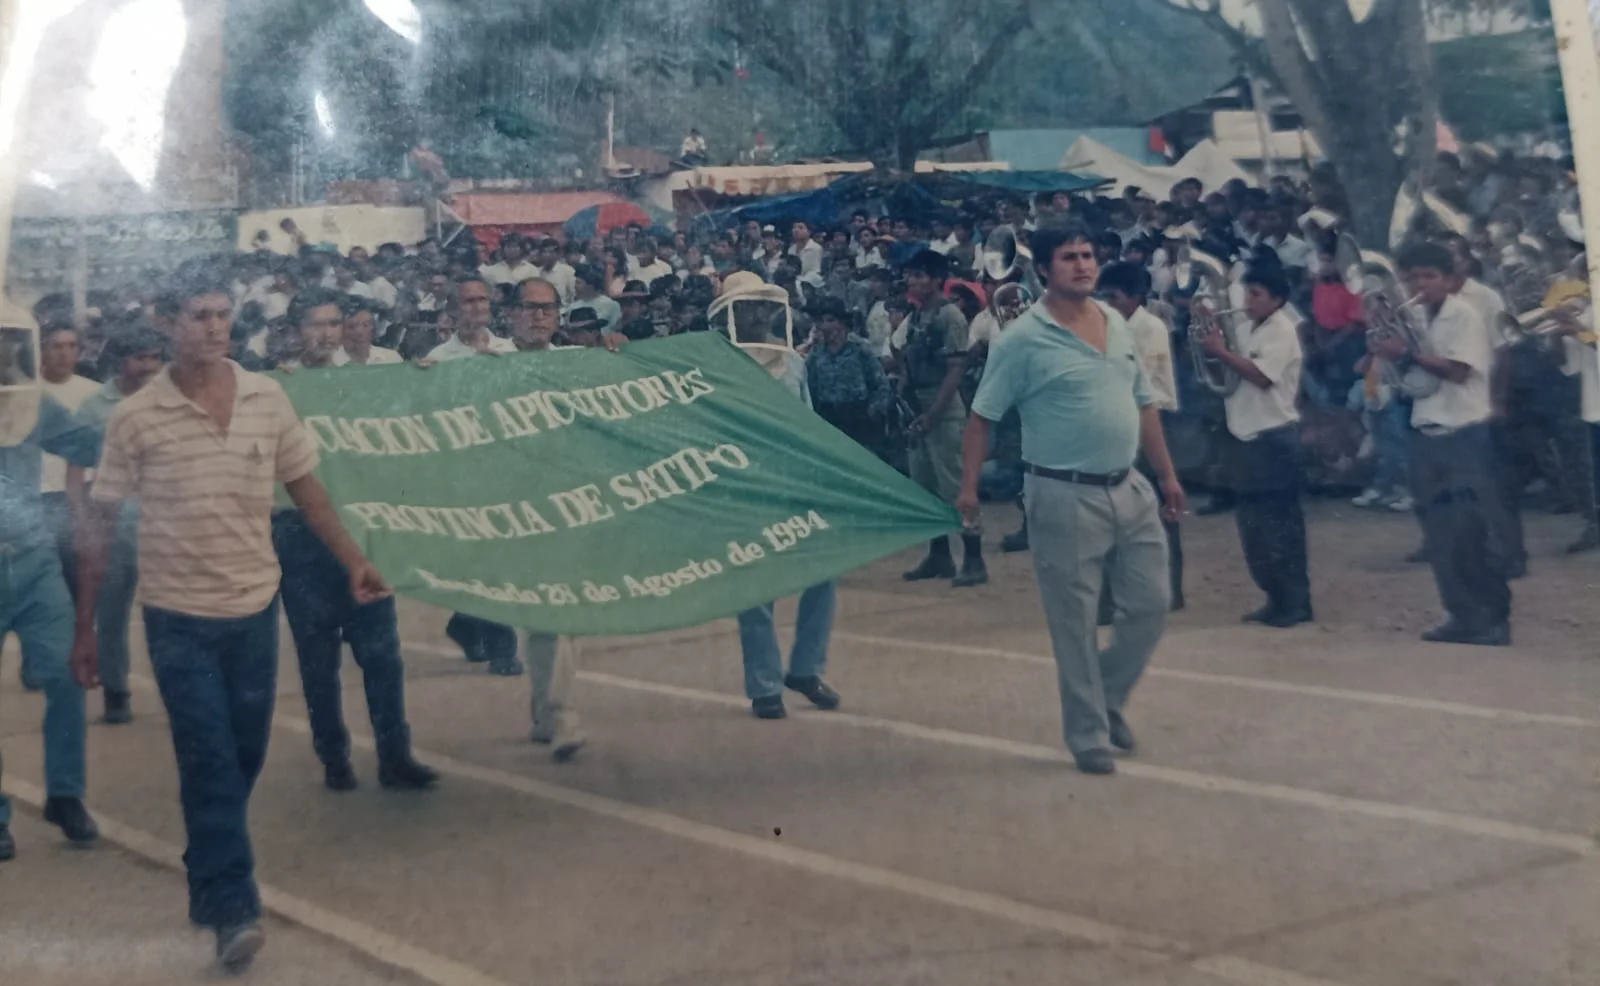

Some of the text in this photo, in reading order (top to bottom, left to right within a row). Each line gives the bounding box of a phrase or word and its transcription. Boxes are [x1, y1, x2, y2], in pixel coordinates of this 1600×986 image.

[432, 405, 496, 449] DE
[490, 367, 716, 439] APICULTORES
[344, 501, 556, 540] PROVINCIA
[548, 483, 615, 528] DE
[581, 580, 621, 602] de
[623, 555, 724, 598] Agosto
[726, 541, 765, 566] de
[762, 509, 830, 552] 1994
